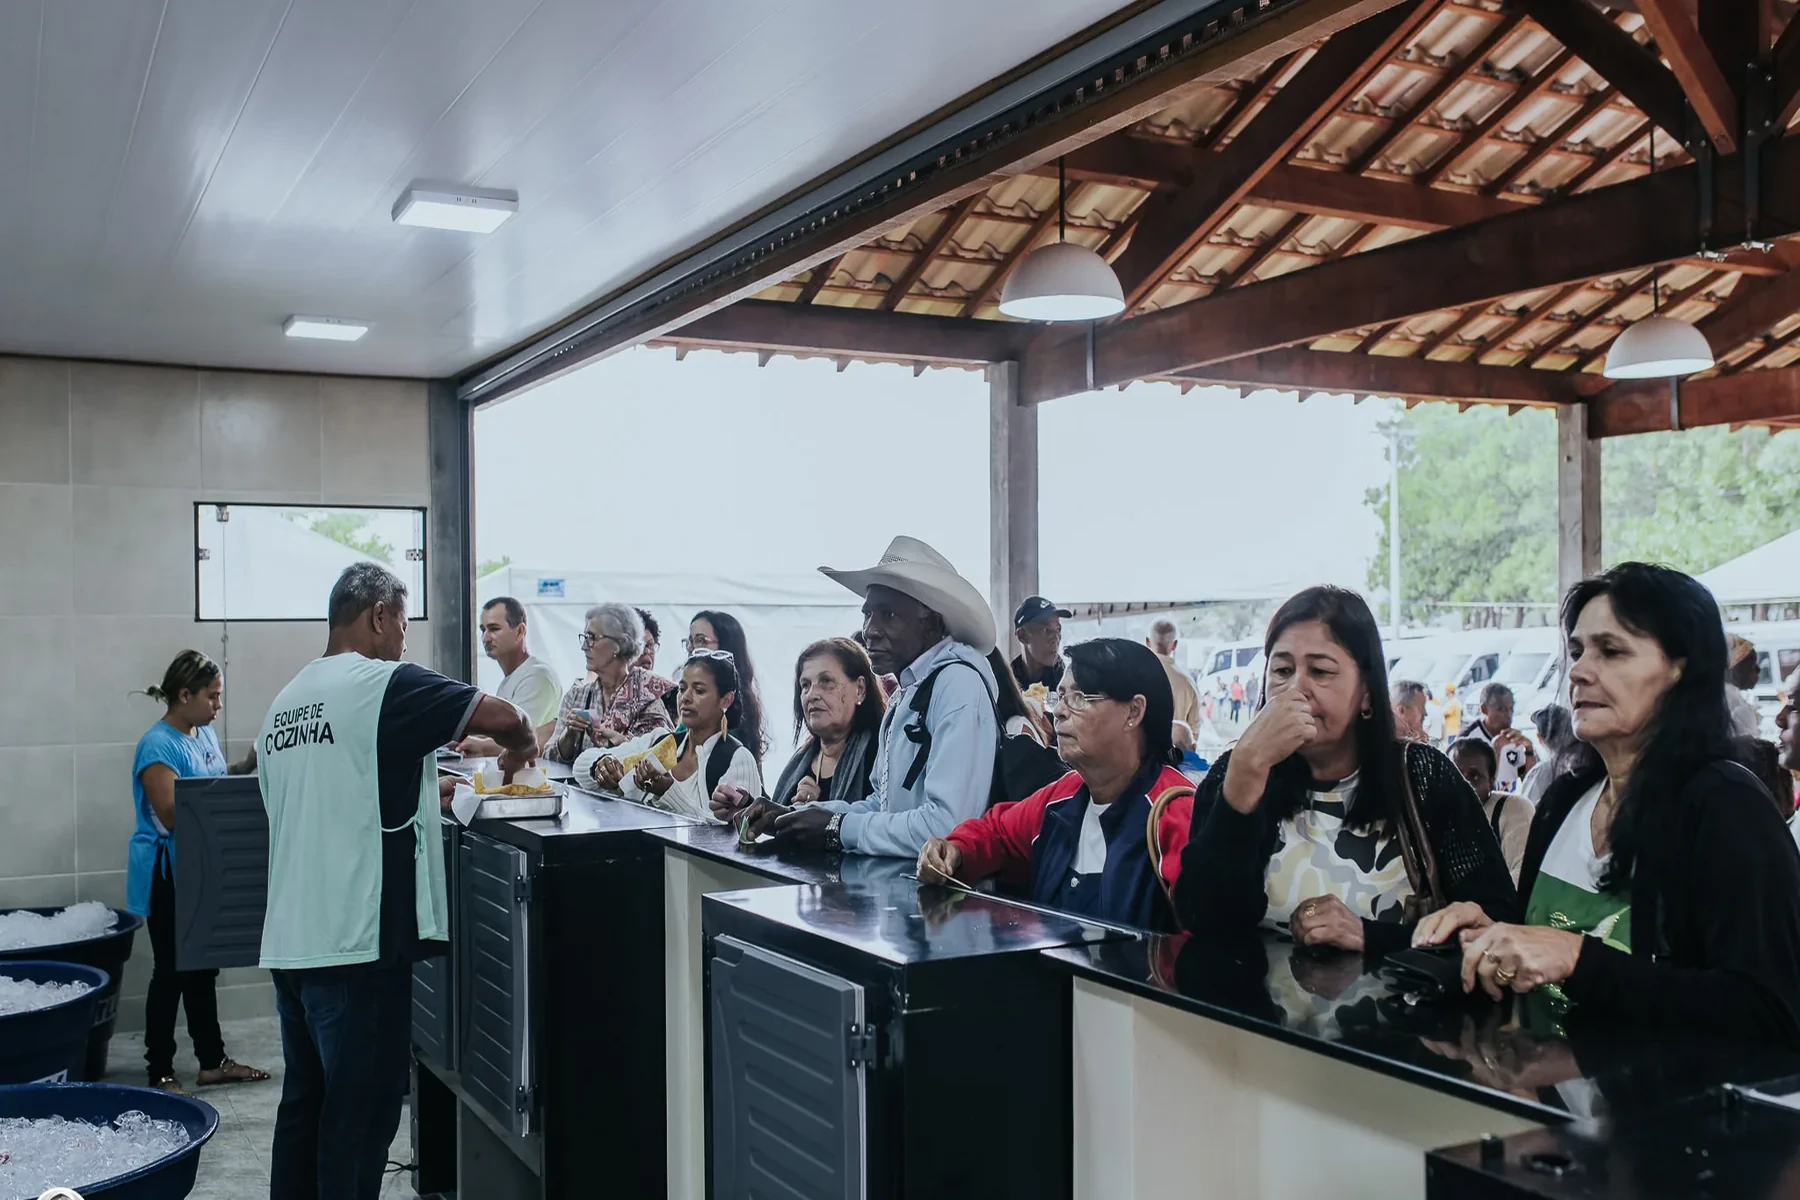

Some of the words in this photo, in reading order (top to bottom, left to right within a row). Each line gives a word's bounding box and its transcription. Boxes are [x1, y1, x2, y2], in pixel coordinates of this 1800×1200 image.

[274, 705, 310, 728] EQUIPE
[310, 702, 324, 720] DE
[265, 721, 335, 756] COZINHA
